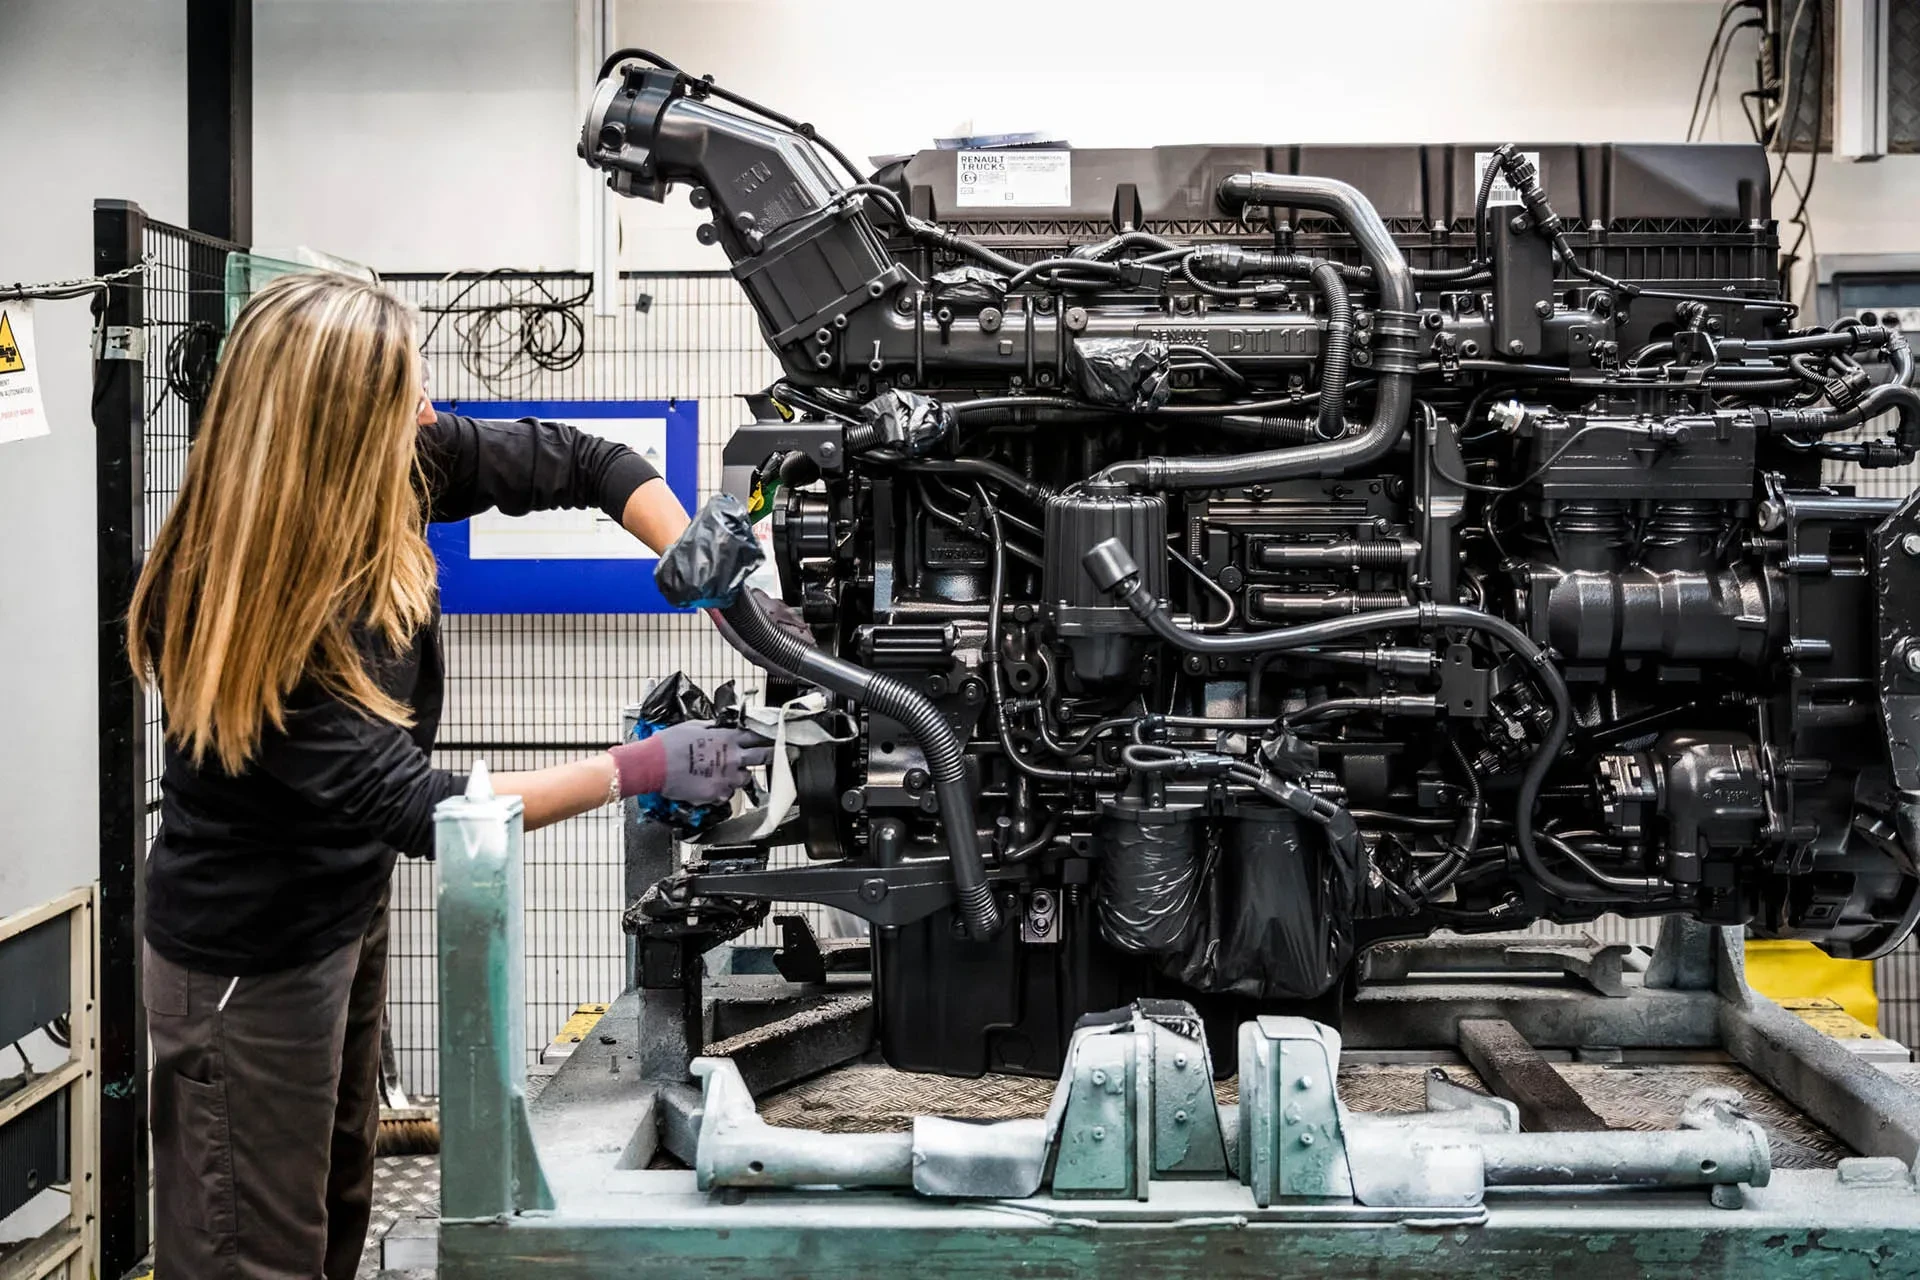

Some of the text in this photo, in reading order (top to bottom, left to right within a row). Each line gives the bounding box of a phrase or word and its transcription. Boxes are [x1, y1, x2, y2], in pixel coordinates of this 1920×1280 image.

[1151, 329, 1307, 353] RENAULT DTI 11
